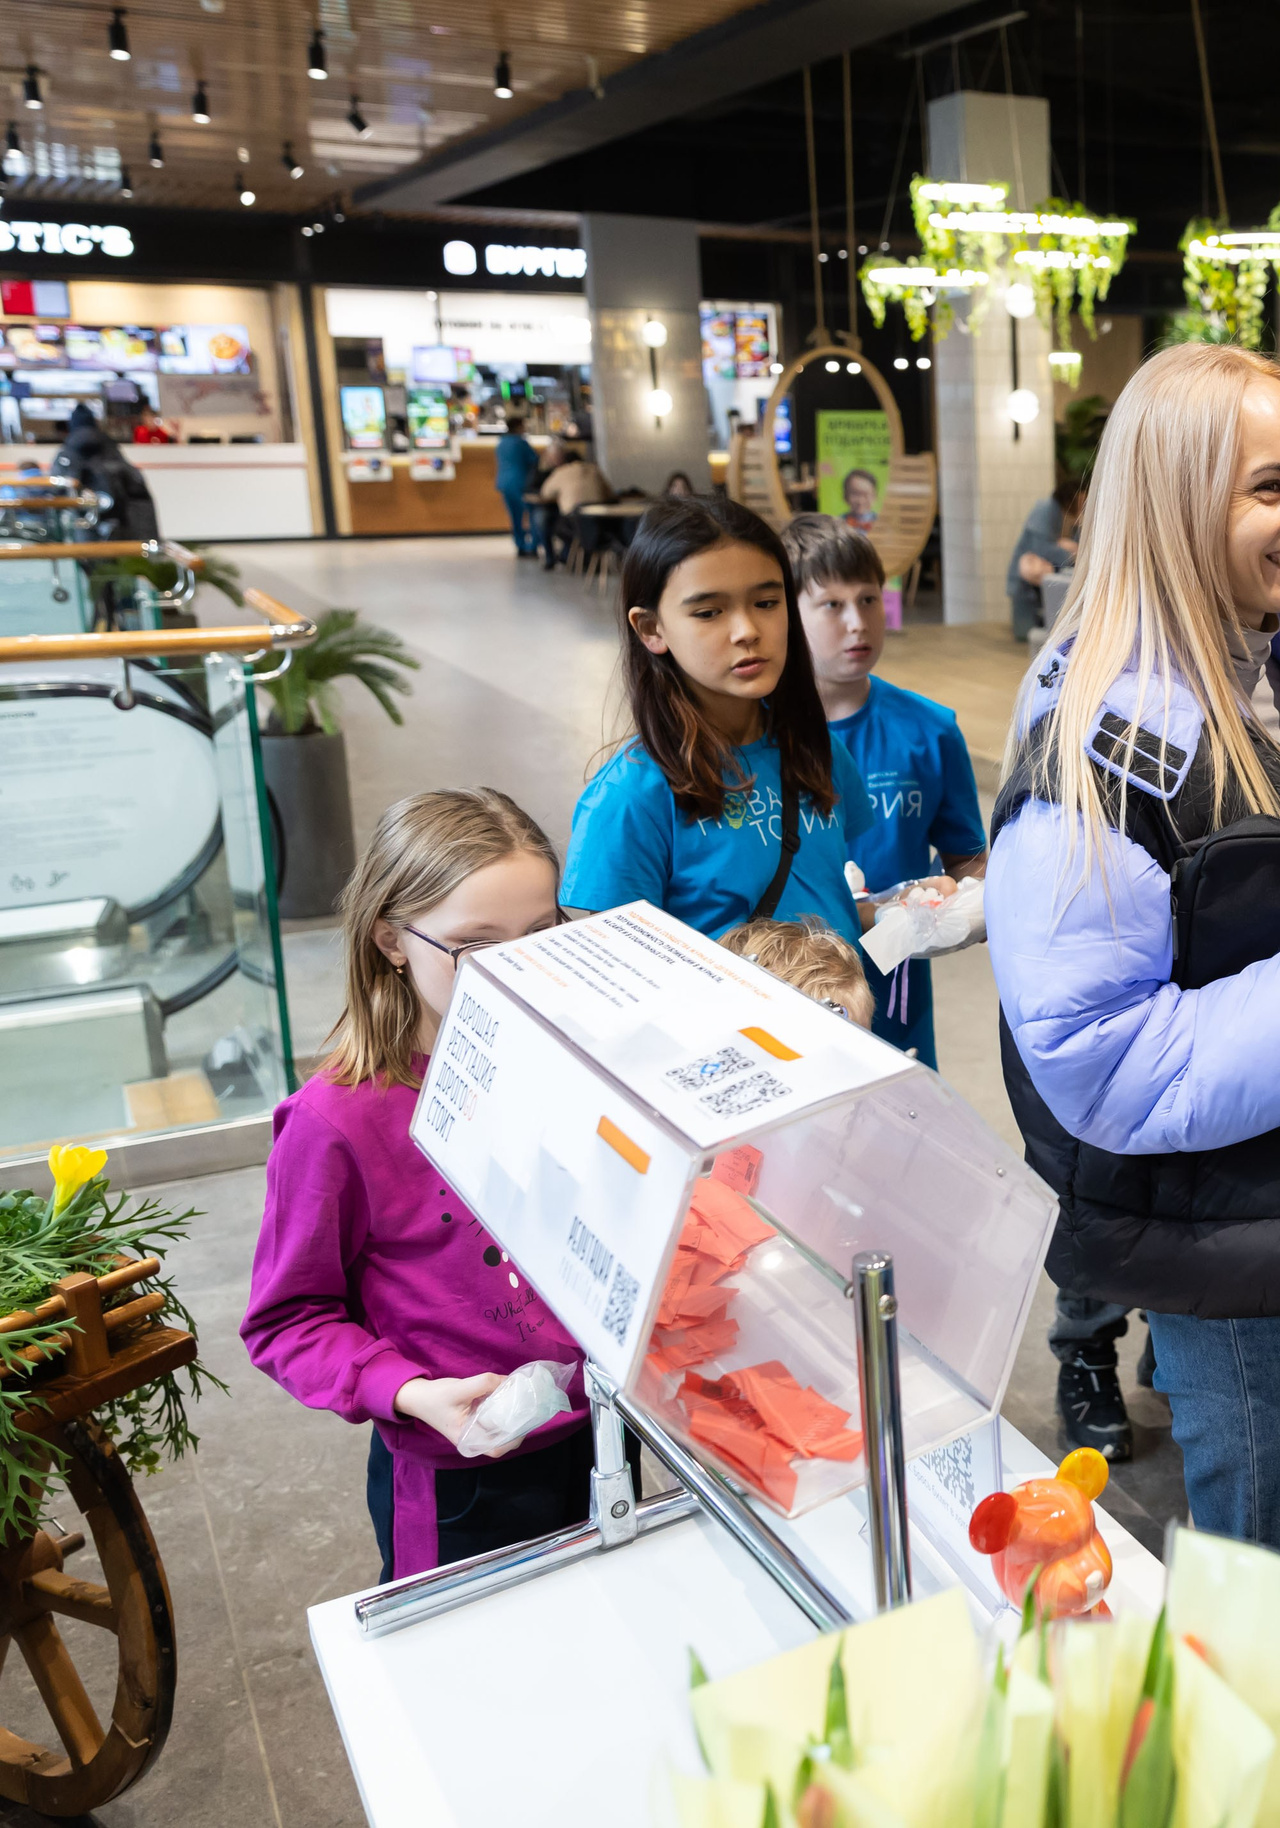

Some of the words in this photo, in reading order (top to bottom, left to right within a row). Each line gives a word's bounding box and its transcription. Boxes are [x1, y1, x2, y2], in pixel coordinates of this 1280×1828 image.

[457, 991, 499, 1048] ХОРОШАЯ
[447, 1025, 498, 1093] РЕПУТАЦИЯ
[427, 1095, 456, 1142] СТОИТ
